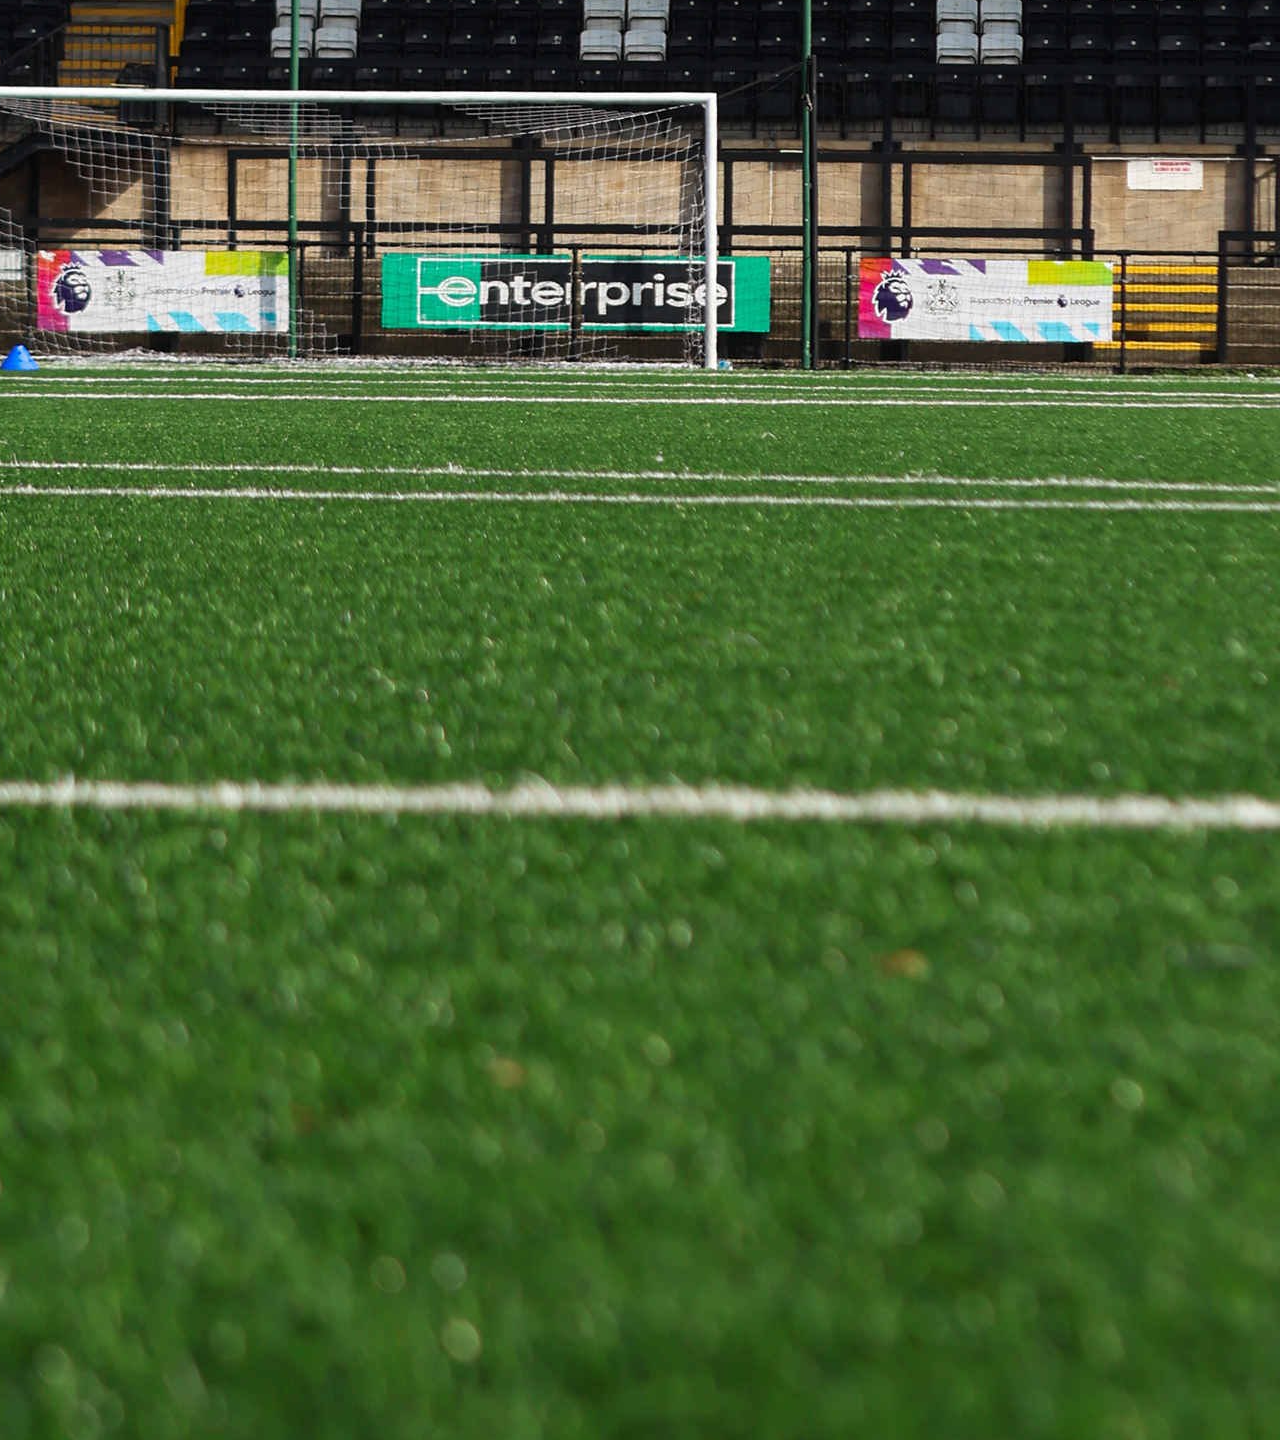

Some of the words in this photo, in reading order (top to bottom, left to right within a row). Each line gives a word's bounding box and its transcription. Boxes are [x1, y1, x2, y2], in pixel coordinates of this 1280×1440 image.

[148, 286, 190, 296] Supported
[202, 286, 232, 295] Premier
[247, 287, 276, 296] League
[436, 272, 729, 316] enterprise
[970, 296, 1011, 306] Supported
[1023, 297, 1054, 305] Premier
[1070, 297, 1101, 307] League
